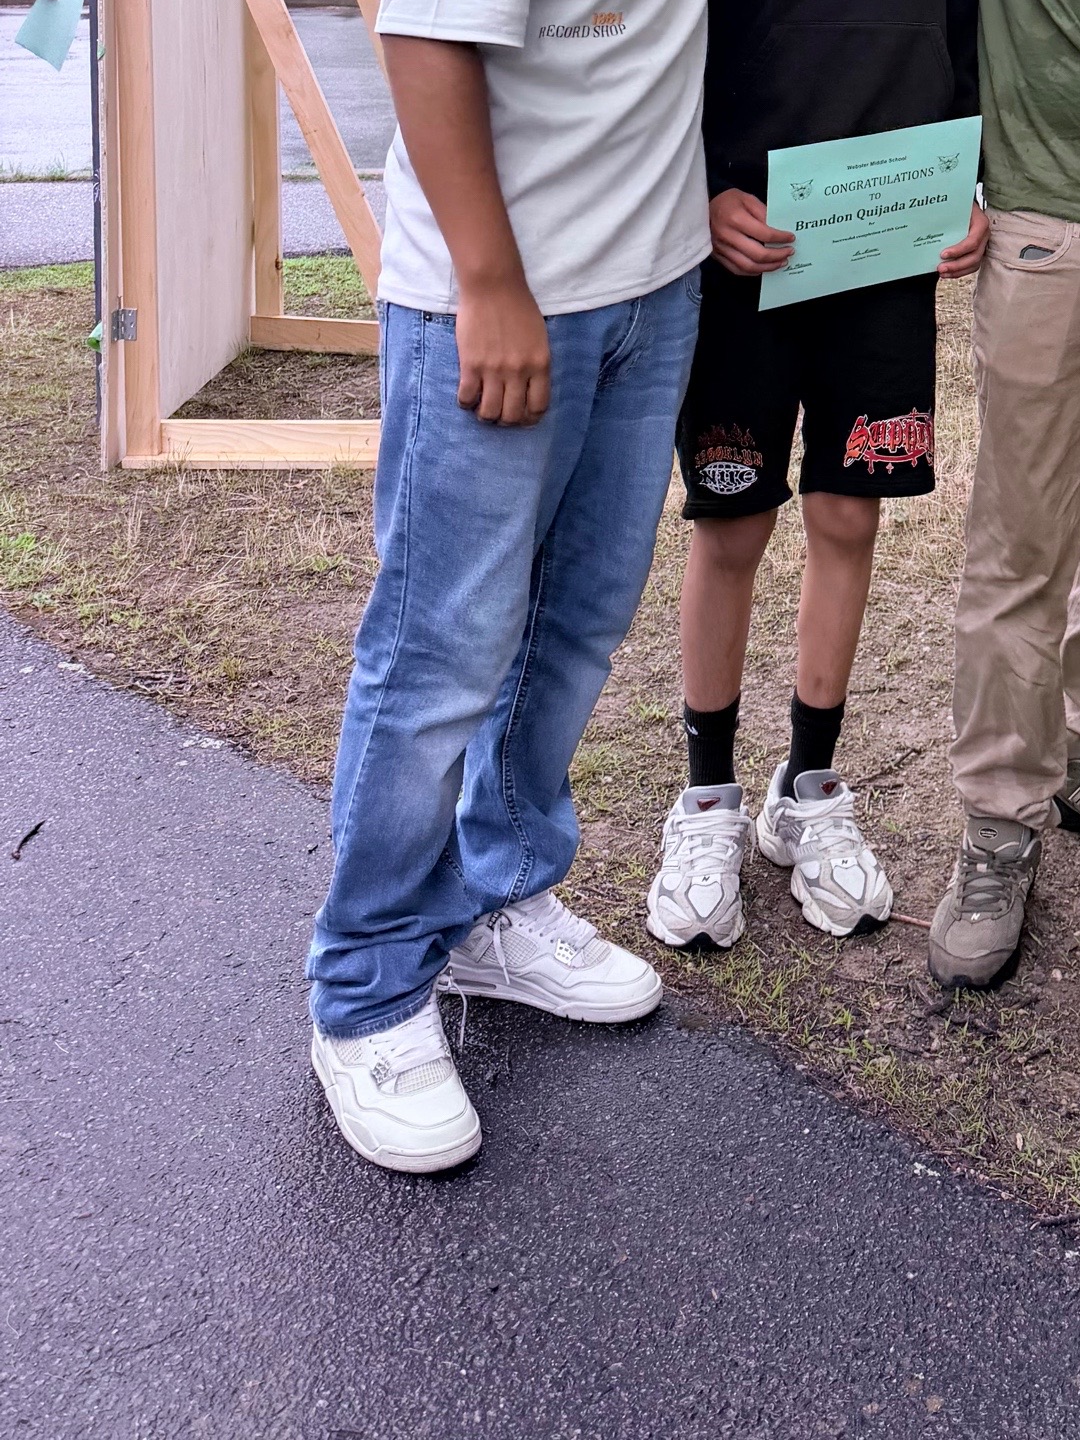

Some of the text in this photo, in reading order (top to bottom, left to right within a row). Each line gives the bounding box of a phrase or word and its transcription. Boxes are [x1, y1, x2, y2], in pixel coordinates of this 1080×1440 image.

[539, 24, 627, 39] RECORD SHOP
[824, 167, 934, 196] CONGRATULATIONS
[869, 192, 881, 201] TO
[795, 193, 948, 232] Brandon Quijada Zuleta
